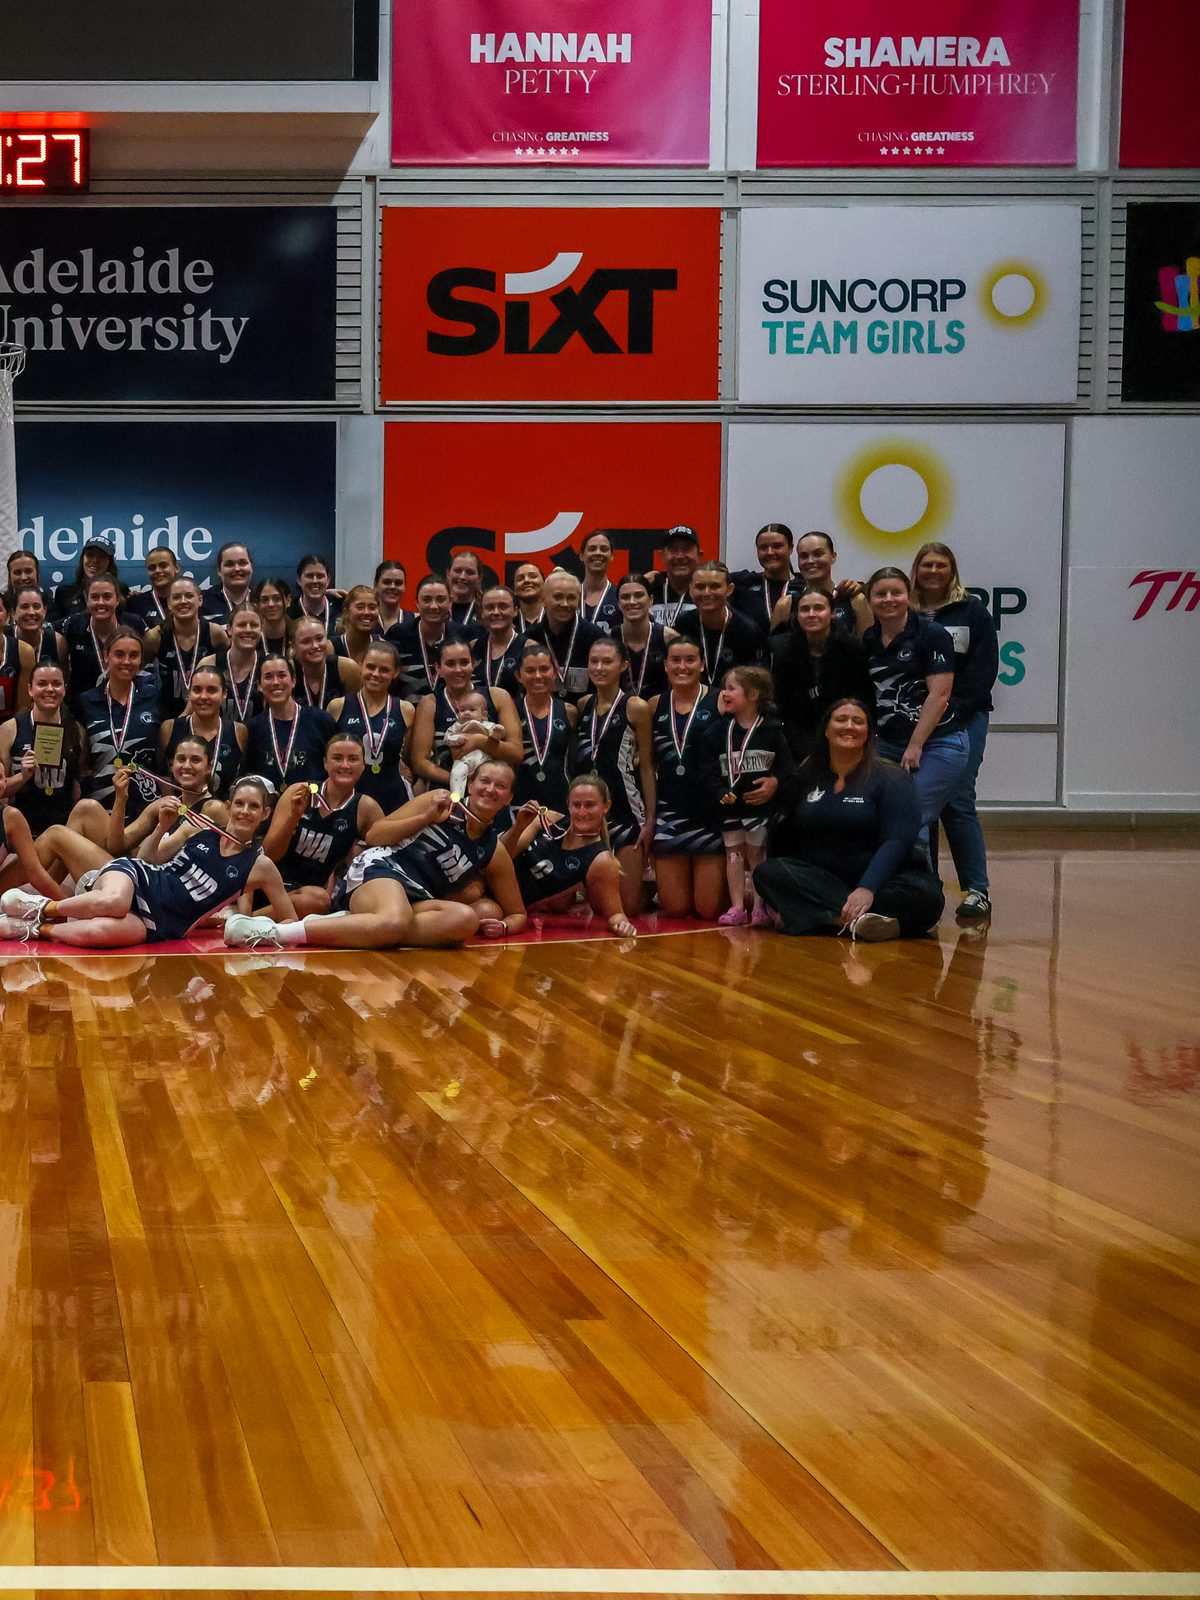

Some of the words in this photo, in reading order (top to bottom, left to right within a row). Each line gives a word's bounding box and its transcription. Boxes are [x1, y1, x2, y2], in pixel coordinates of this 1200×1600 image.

[471, 33, 632, 64] HANNAH
[824, 37, 1011, 68] SHAMERA
[504, 69, 598, 94] PETTY
[777, 73, 1055, 97] STERLING-HUMPHREY
[493, 131, 543, 143] CHASING
[545, 131, 610, 143] GREATNESS
[857, 131, 909, 142] CHASING
[911, 131, 975, 142] GREATNESS
[762, 278, 967, 314] SUNCORP
[762, 320, 858, 355] TEAM
[866, 319, 966, 355] GIRLS
[296, 827, 334, 864] WA
[179, 862, 219, 902] WD
